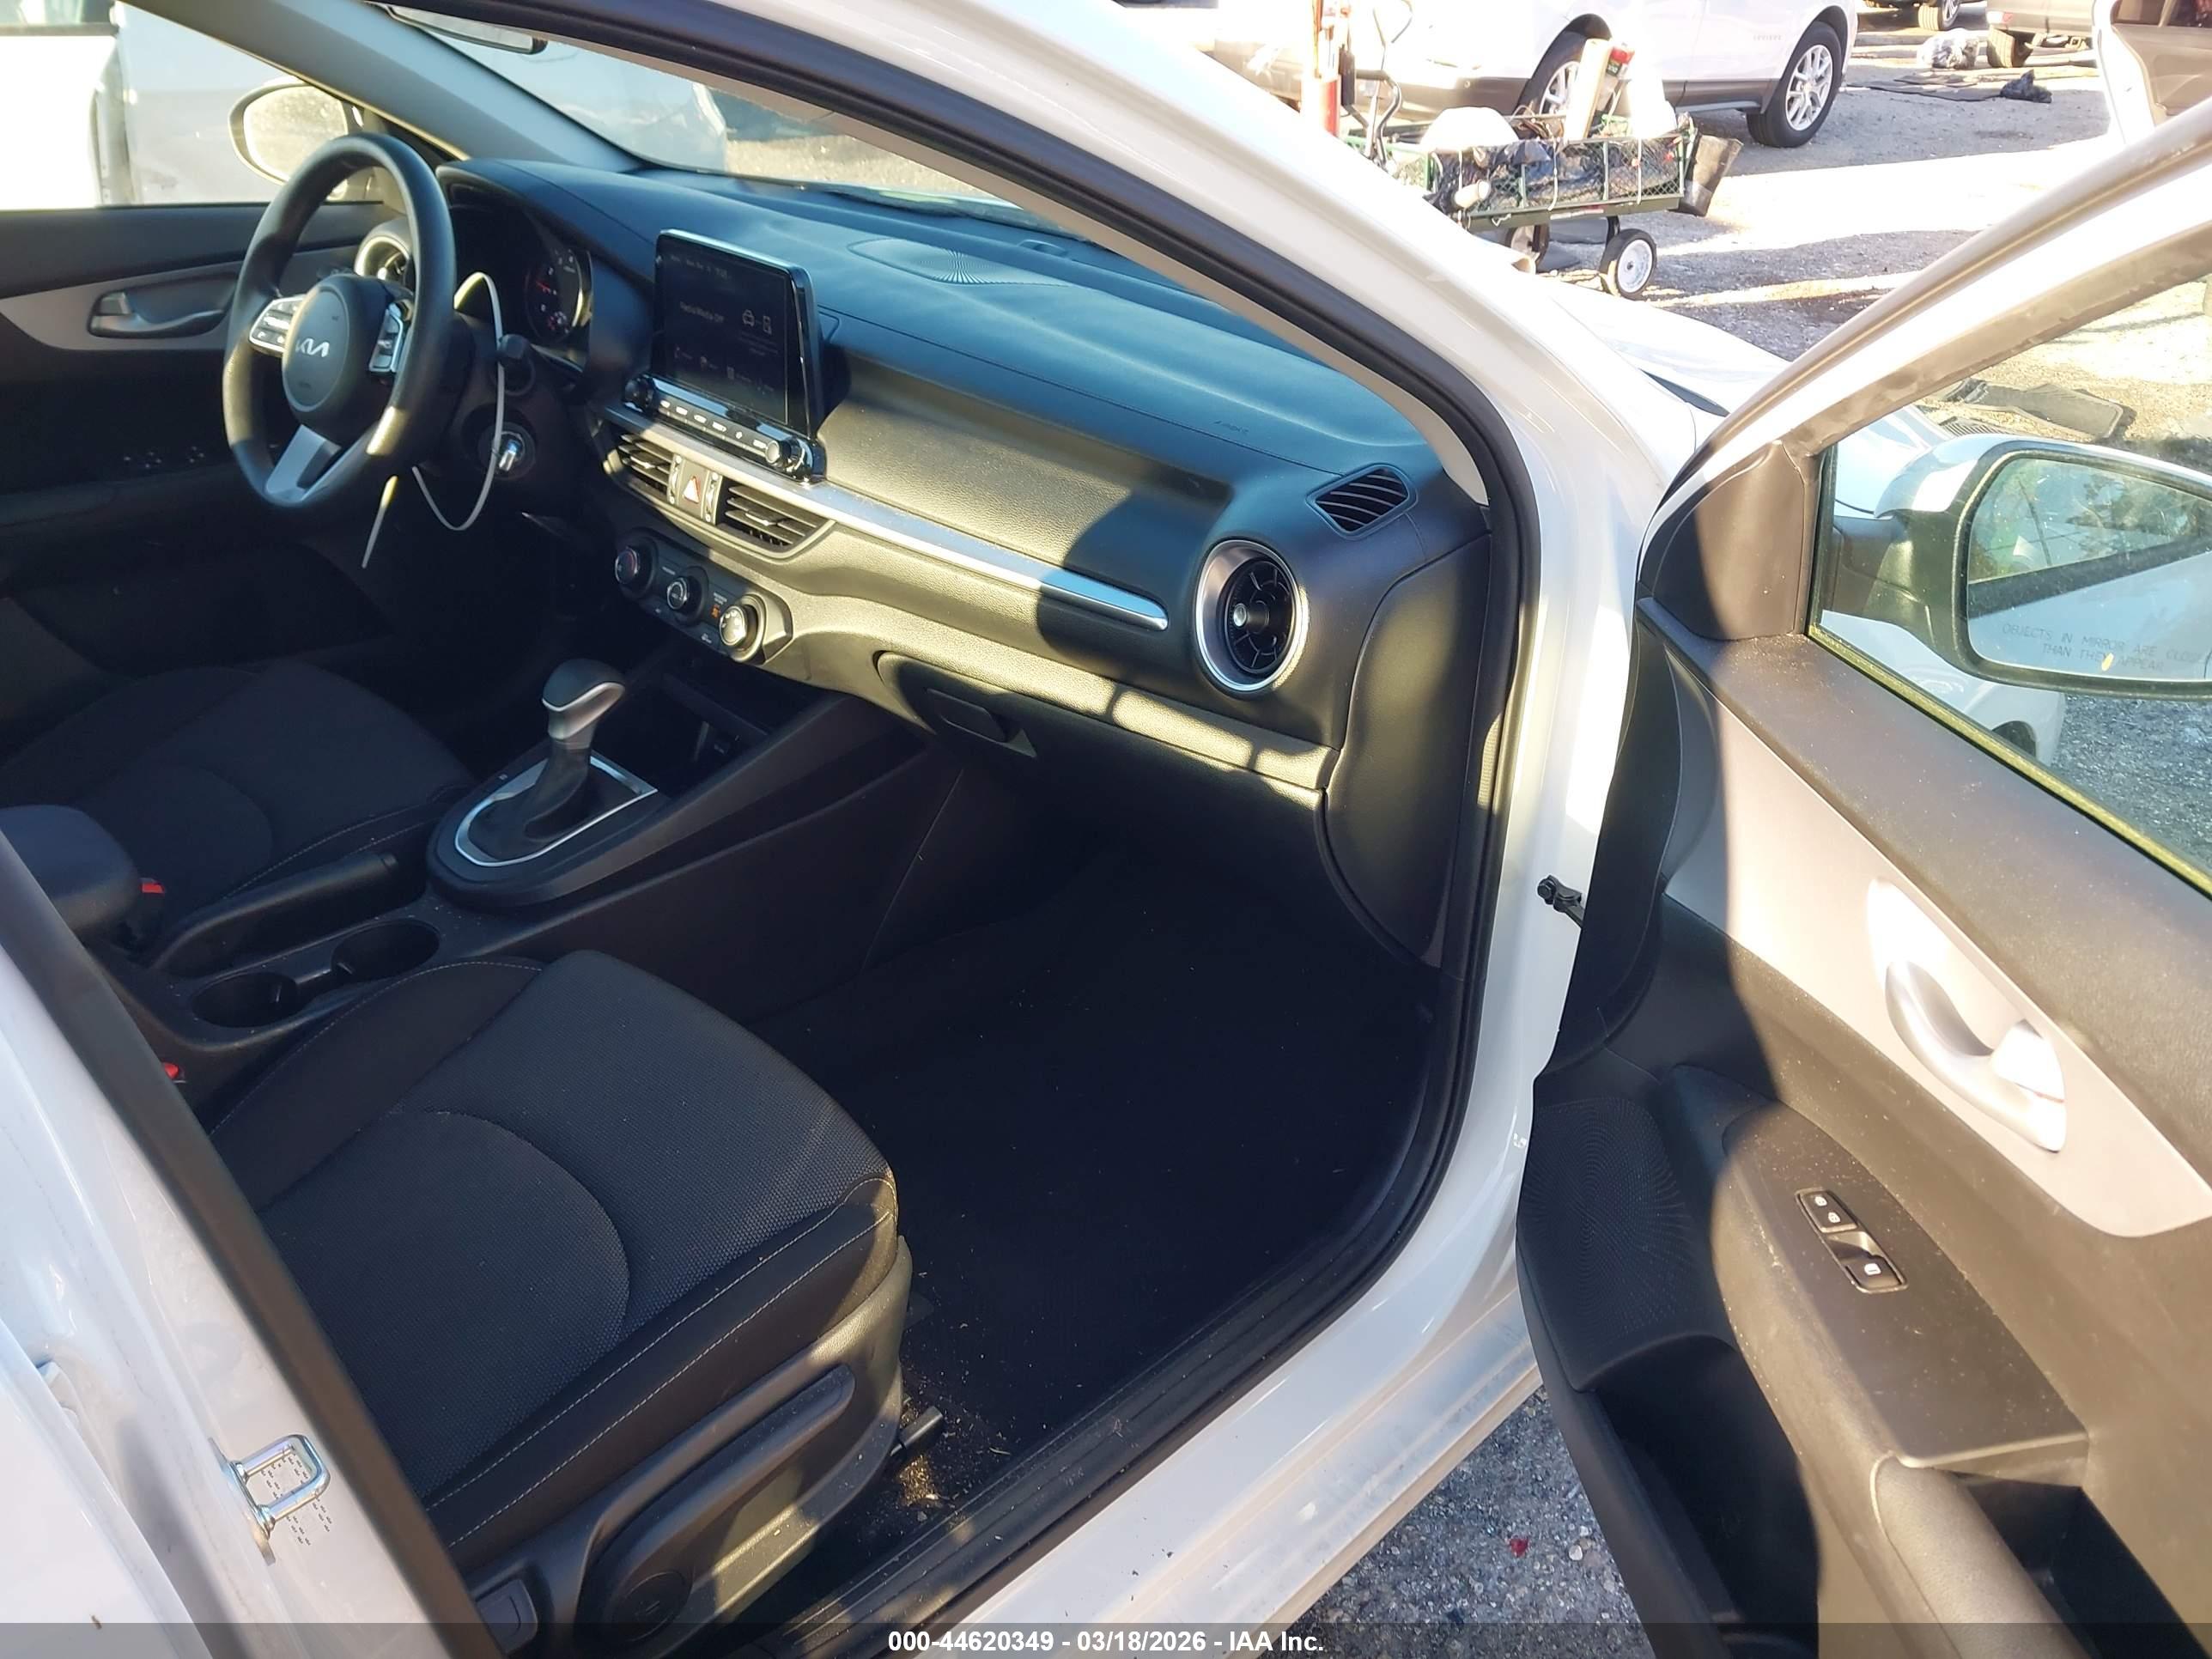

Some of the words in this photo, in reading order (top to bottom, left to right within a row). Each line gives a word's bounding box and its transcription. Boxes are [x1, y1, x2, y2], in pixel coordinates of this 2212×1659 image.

[2002, 623, 2053, 641] OBJECTS
[2061, 632, 2074, 644] IN
[2081, 635, 2126, 653] MIRROR
[2133, 643, 2158, 657] ARE
[2043, 642, 2073, 659] THAN
